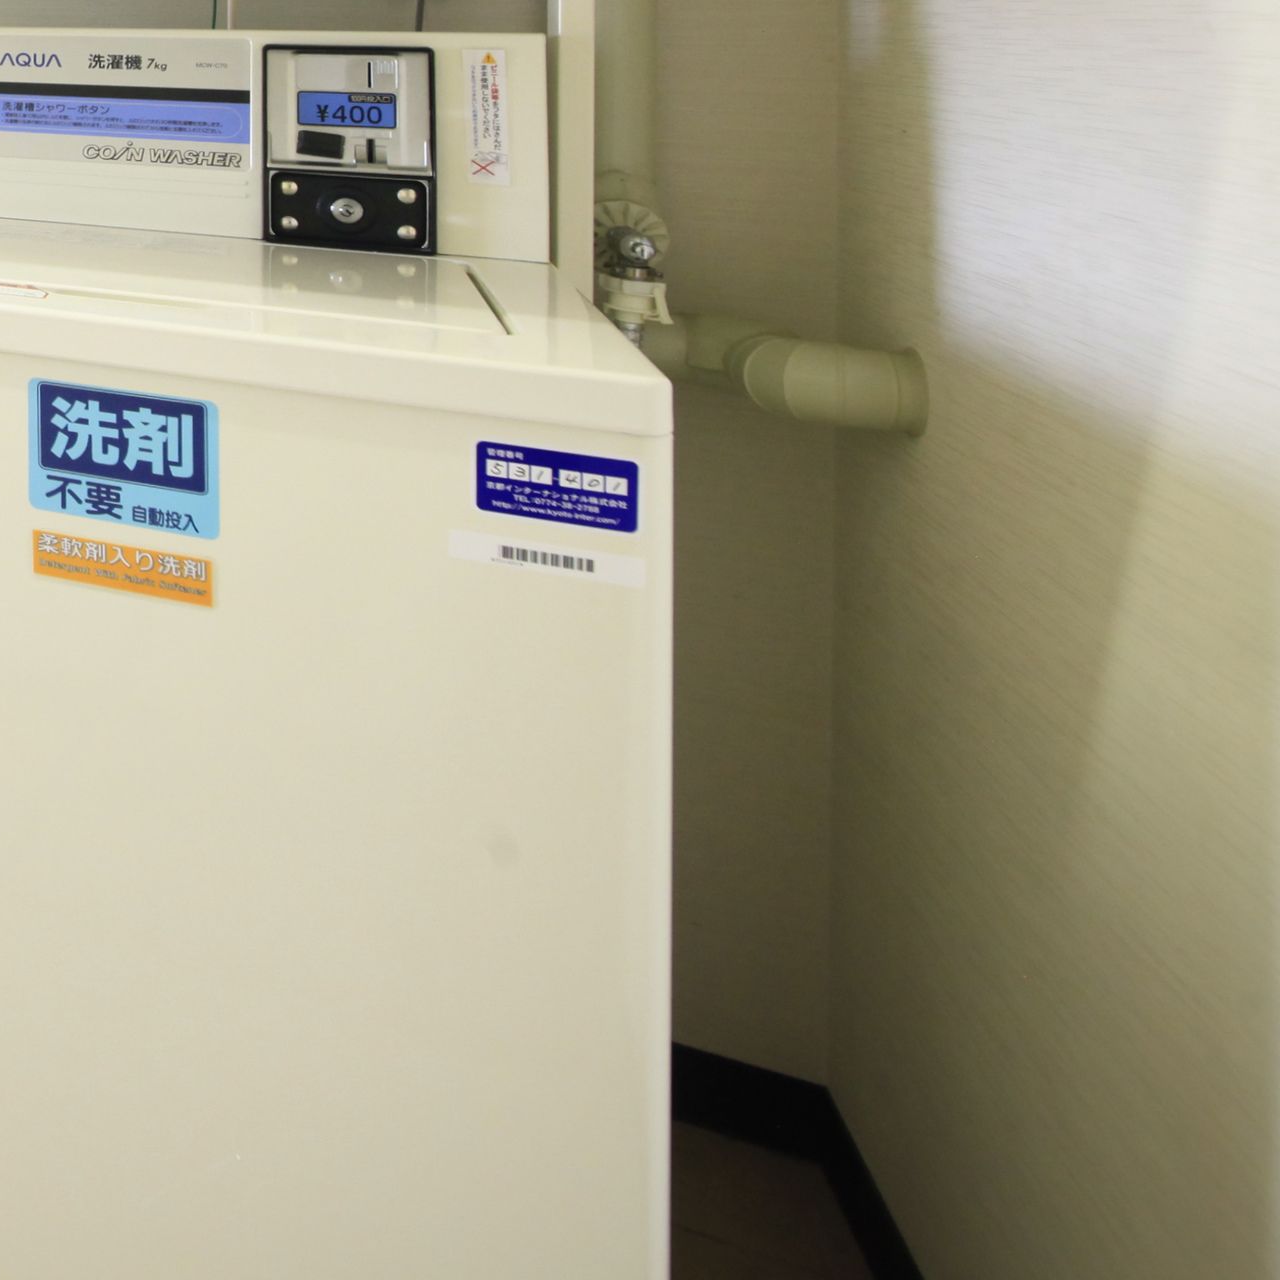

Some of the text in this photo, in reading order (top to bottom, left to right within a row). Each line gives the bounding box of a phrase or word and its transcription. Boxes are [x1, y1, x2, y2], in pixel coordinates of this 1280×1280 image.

[0, 52, 62, 68] AQUA
[88, 54, 168, 71] 洗濯機 7kg
[2, 101, 110, 115] 洗濯槽シャワーボタン
[316, 104, 382, 124] ¥400
[149, 146, 242, 168] WASHER
[50, 396, 194, 479] 洗剤
[45, 474, 200, 534] 不要 自動投入
[37, 533, 207, 582] 柔軟剤入り洗剤
